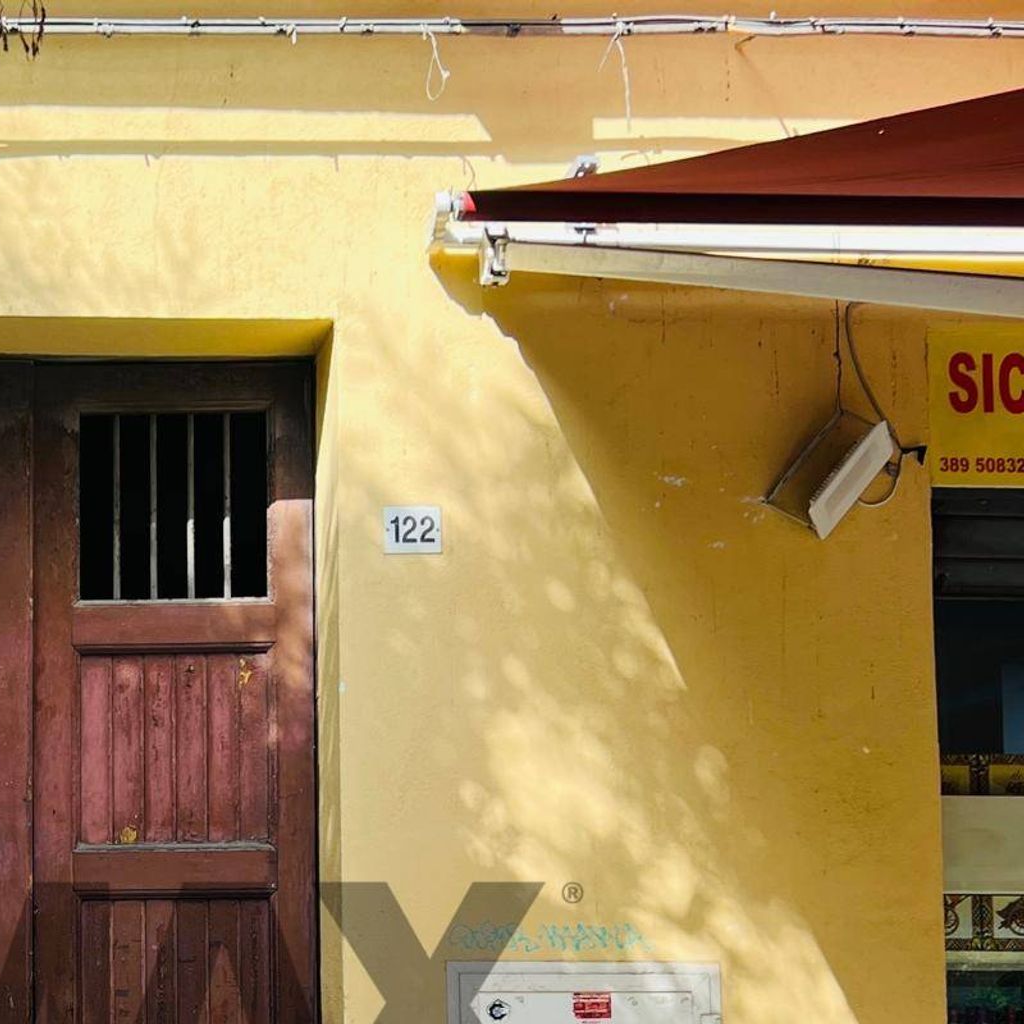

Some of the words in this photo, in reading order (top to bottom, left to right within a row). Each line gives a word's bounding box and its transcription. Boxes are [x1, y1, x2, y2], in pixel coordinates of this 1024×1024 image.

[948, 351, 1024, 414] SIC
[940, 457, 969, 473] 389
[975, 458, 1024, 473] 50832
[390, 515, 435, 543] 122
